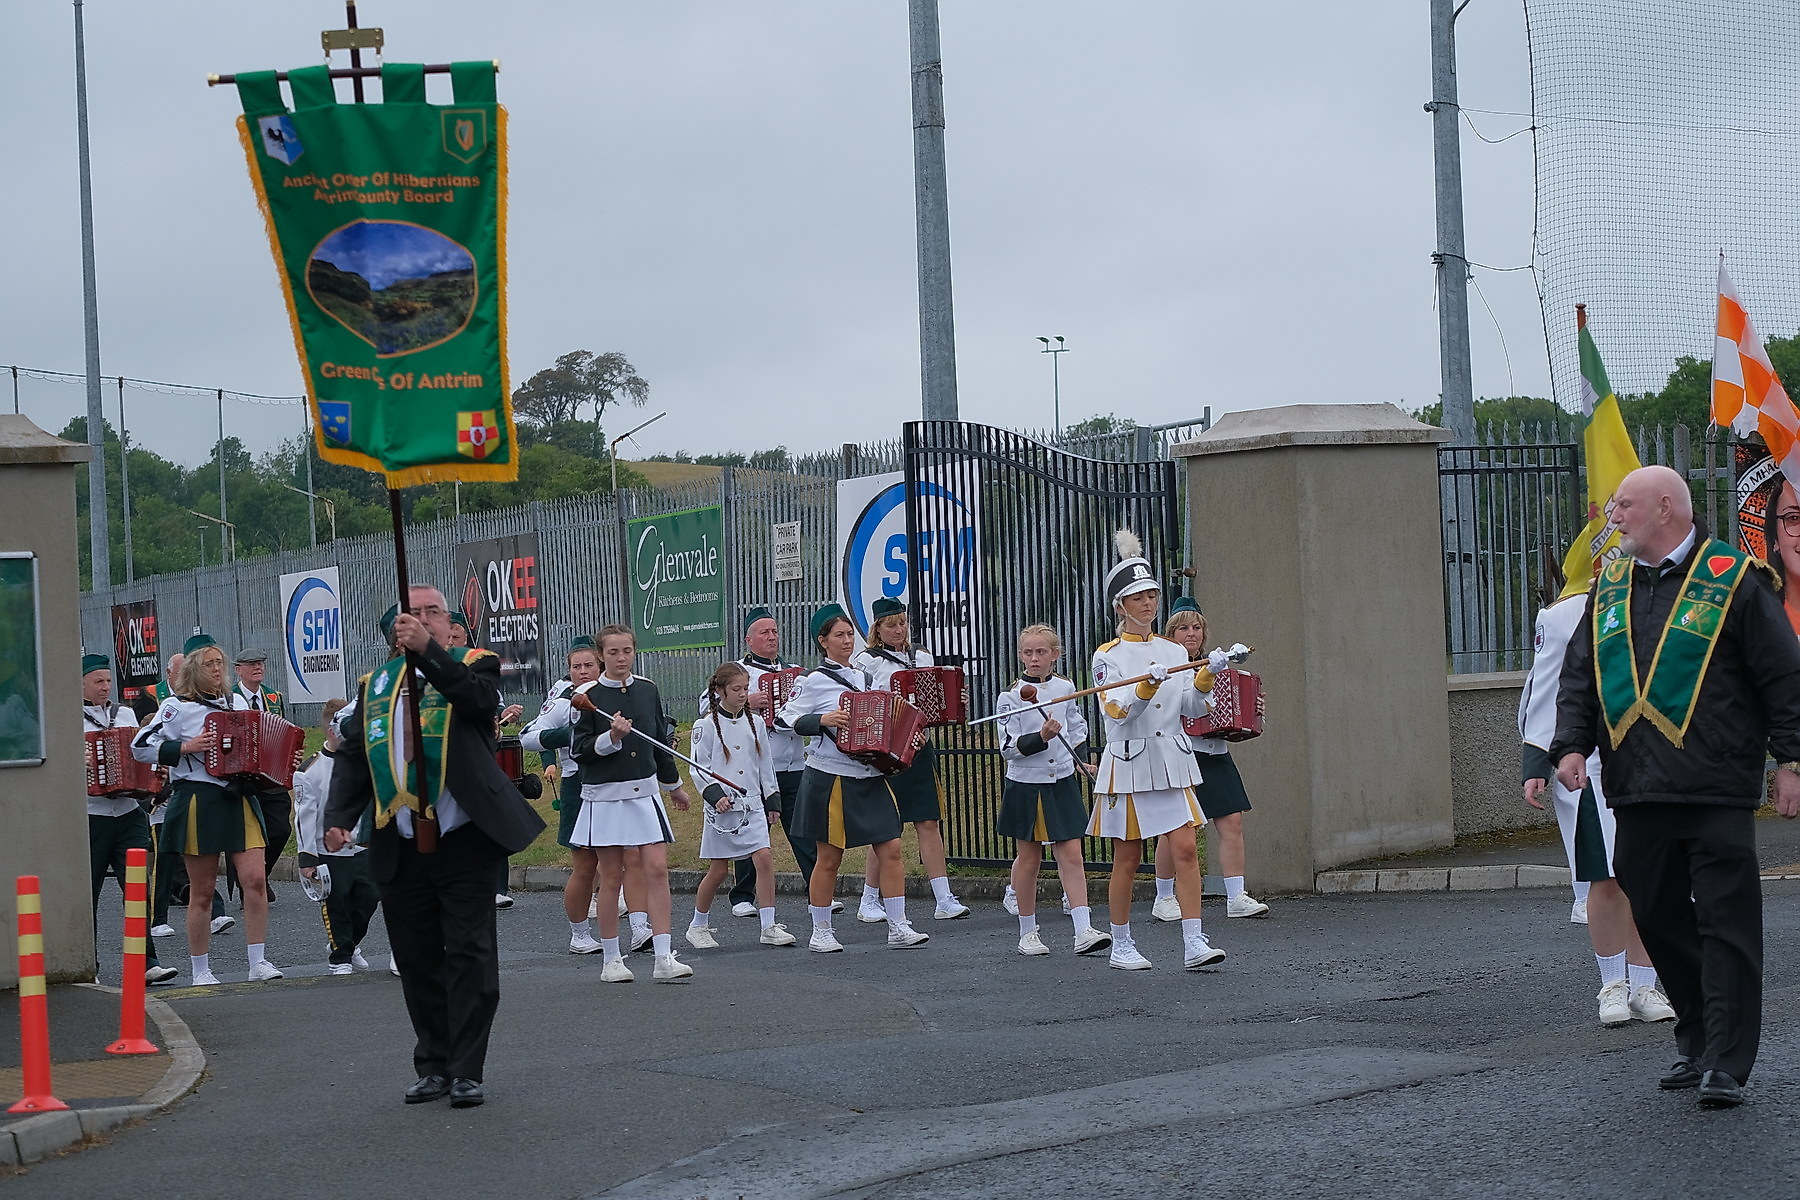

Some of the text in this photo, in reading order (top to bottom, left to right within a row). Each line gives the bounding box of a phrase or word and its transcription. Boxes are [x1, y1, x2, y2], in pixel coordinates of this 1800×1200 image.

[283, 173, 330, 190] Ancit
[371, 172, 390, 186] Of
[392, 172, 481, 188] Hibernians
[355, 189, 400, 205] ounty
[403, 189, 454, 203] Board
[320, 361, 371, 381] Green
[389, 372, 414, 391] Of
[418, 371, 483, 389] Antrim
[1749, 461, 1780, 486] MHAC
[487, 556, 537, 613] OKEE
[636, 525, 718, 630] Glenvale
[658, 590, 719, 608] Kitchens & Bedrooms
[128, 616, 157, 655] OKEE
[302, 607, 339, 653] SFM
[489, 612, 539, 643] ELECTRICS
[130, 655, 159, 677] ELECTRICS
[303, 653, 340, 674] ENGINEERING
